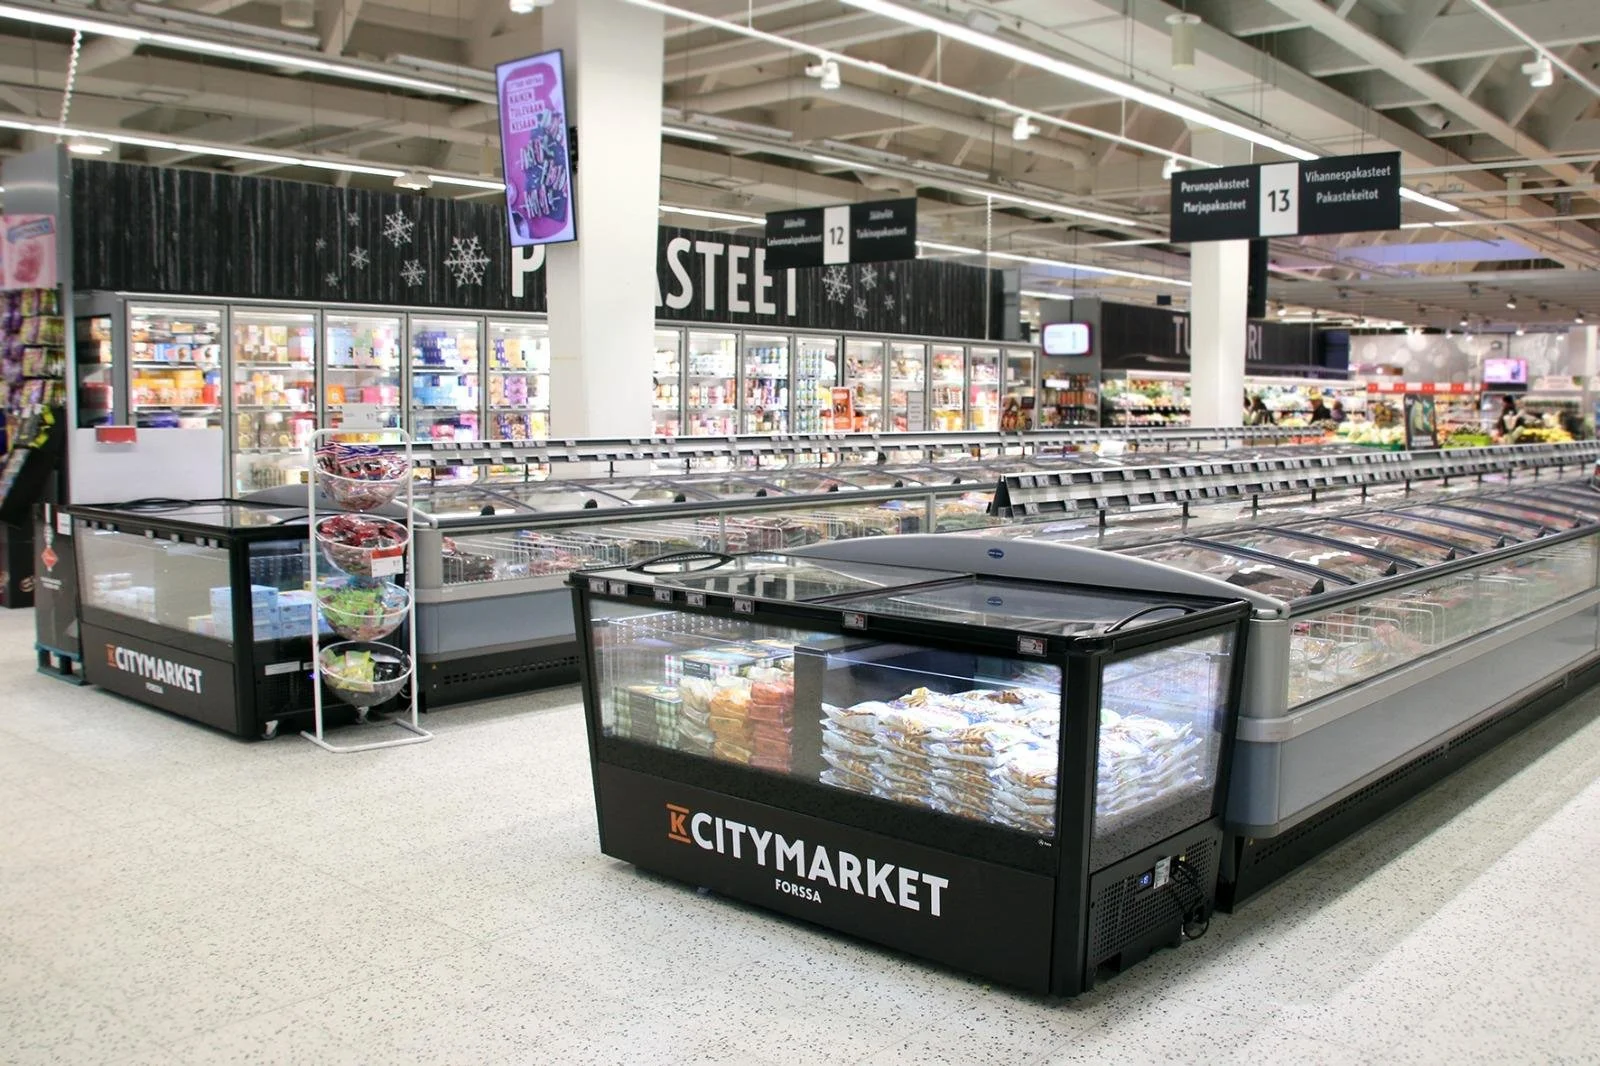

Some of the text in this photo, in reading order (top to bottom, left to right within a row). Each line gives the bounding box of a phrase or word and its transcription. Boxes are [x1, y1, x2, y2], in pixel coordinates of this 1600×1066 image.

[1304, 165, 1391, 183] Vihannespakasteet
[1180, 178, 1250, 194] Perunapakasteet
[1268, 189, 1290, 212] 13
[1316, 188, 1378, 204] Pakastekeitot
[1183, 198, 1246, 215] Marjapakasteet
[830, 226, 844, 245] 12
[774, 878, 823, 904] FORSSA
